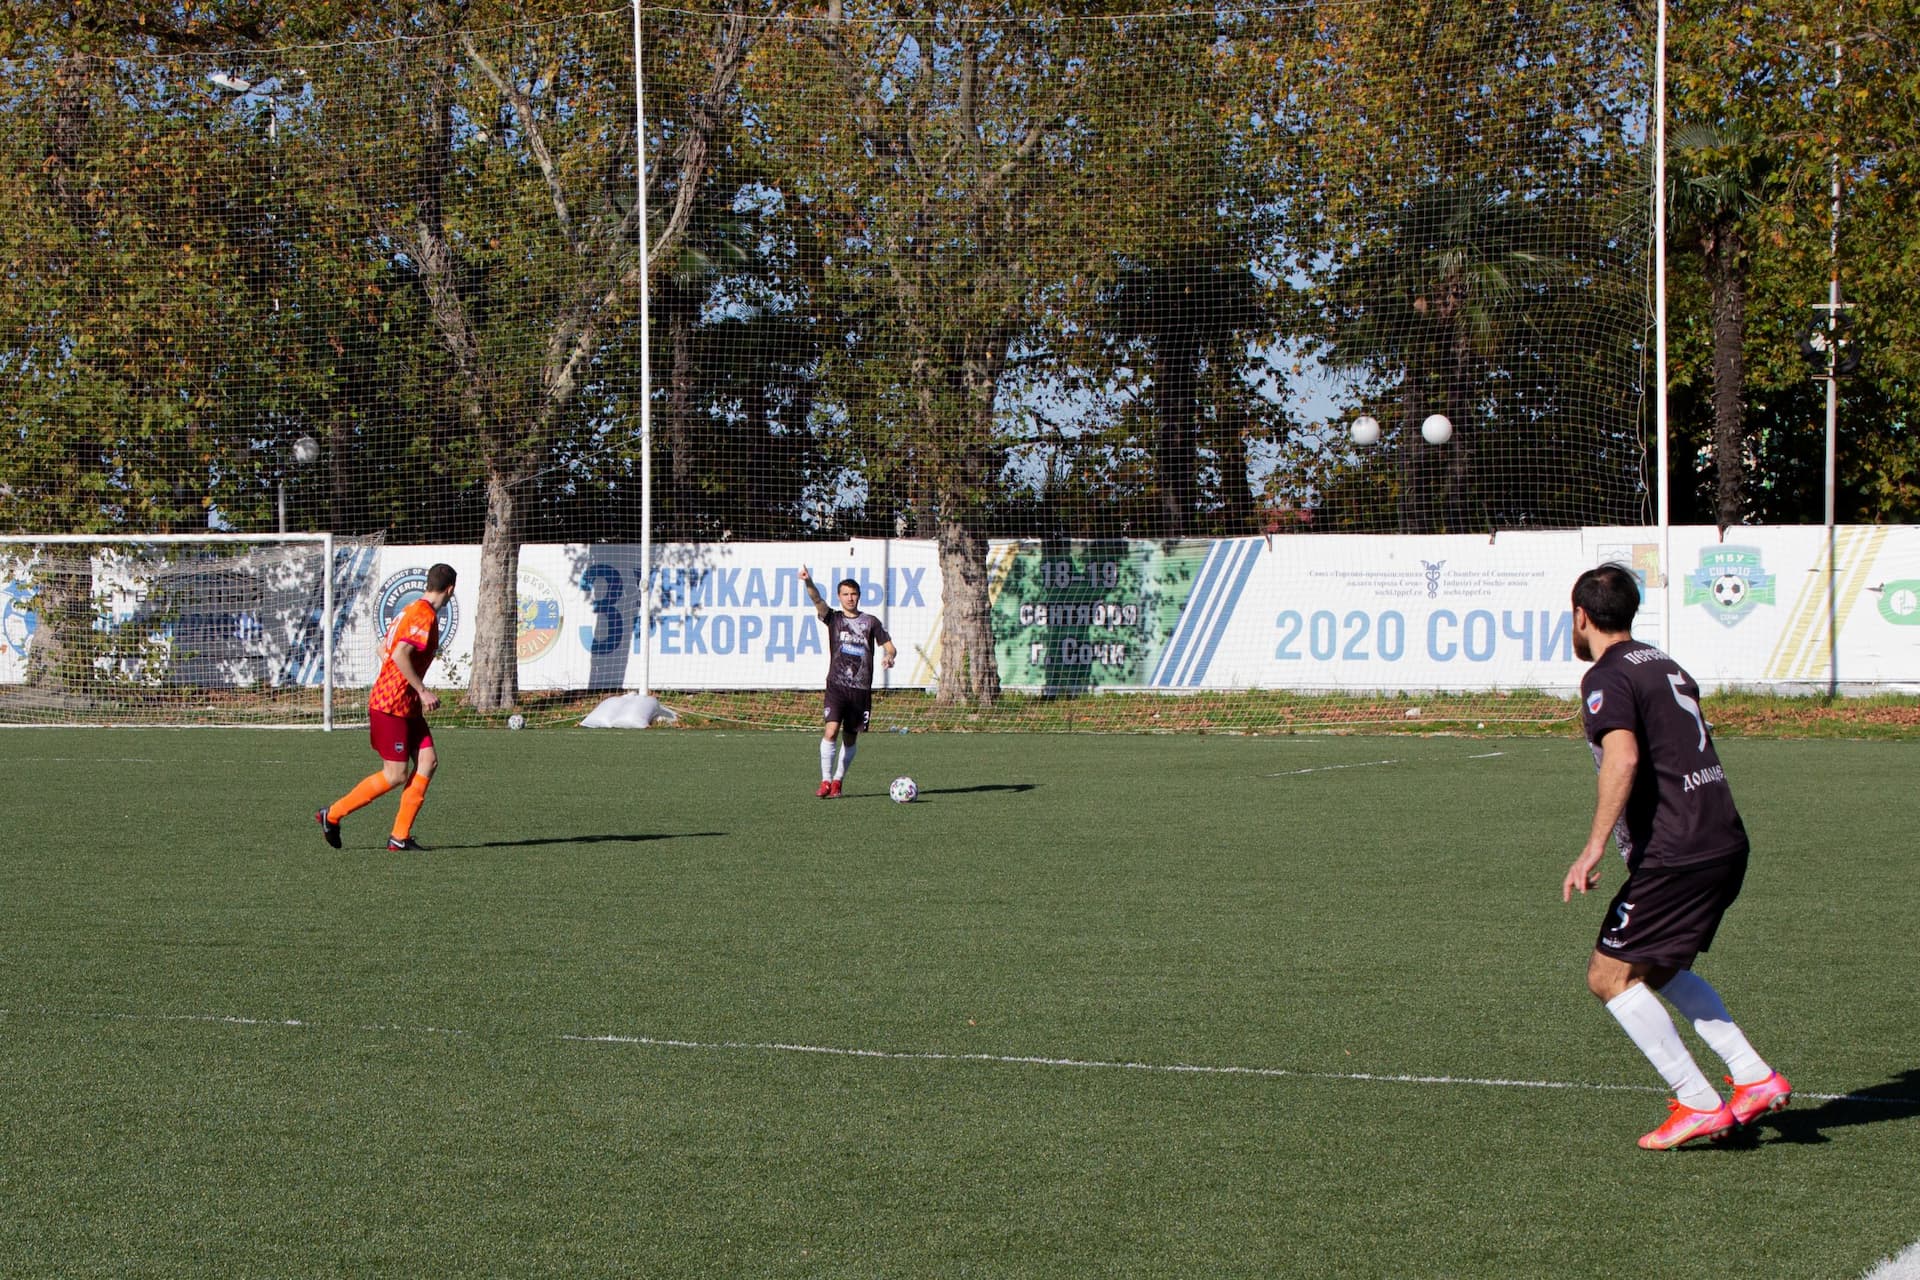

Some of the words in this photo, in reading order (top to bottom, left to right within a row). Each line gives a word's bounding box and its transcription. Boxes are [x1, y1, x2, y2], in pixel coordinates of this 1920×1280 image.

[386, 580, 428, 608] INTERRE
[579, 564, 623, 655] 3
[1020, 600, 1137, 632] сентября
[1275, 610, 1405, 662] 2020
[1427, 609, 1574, 662] СОЧИ
[632, 614, 823, 663] РЕКОРДА
[1061, 637, 1126, 665] Сочи
[1666, 670, 1707, 752] 5
[1610, 901, 1636, 932] 5
